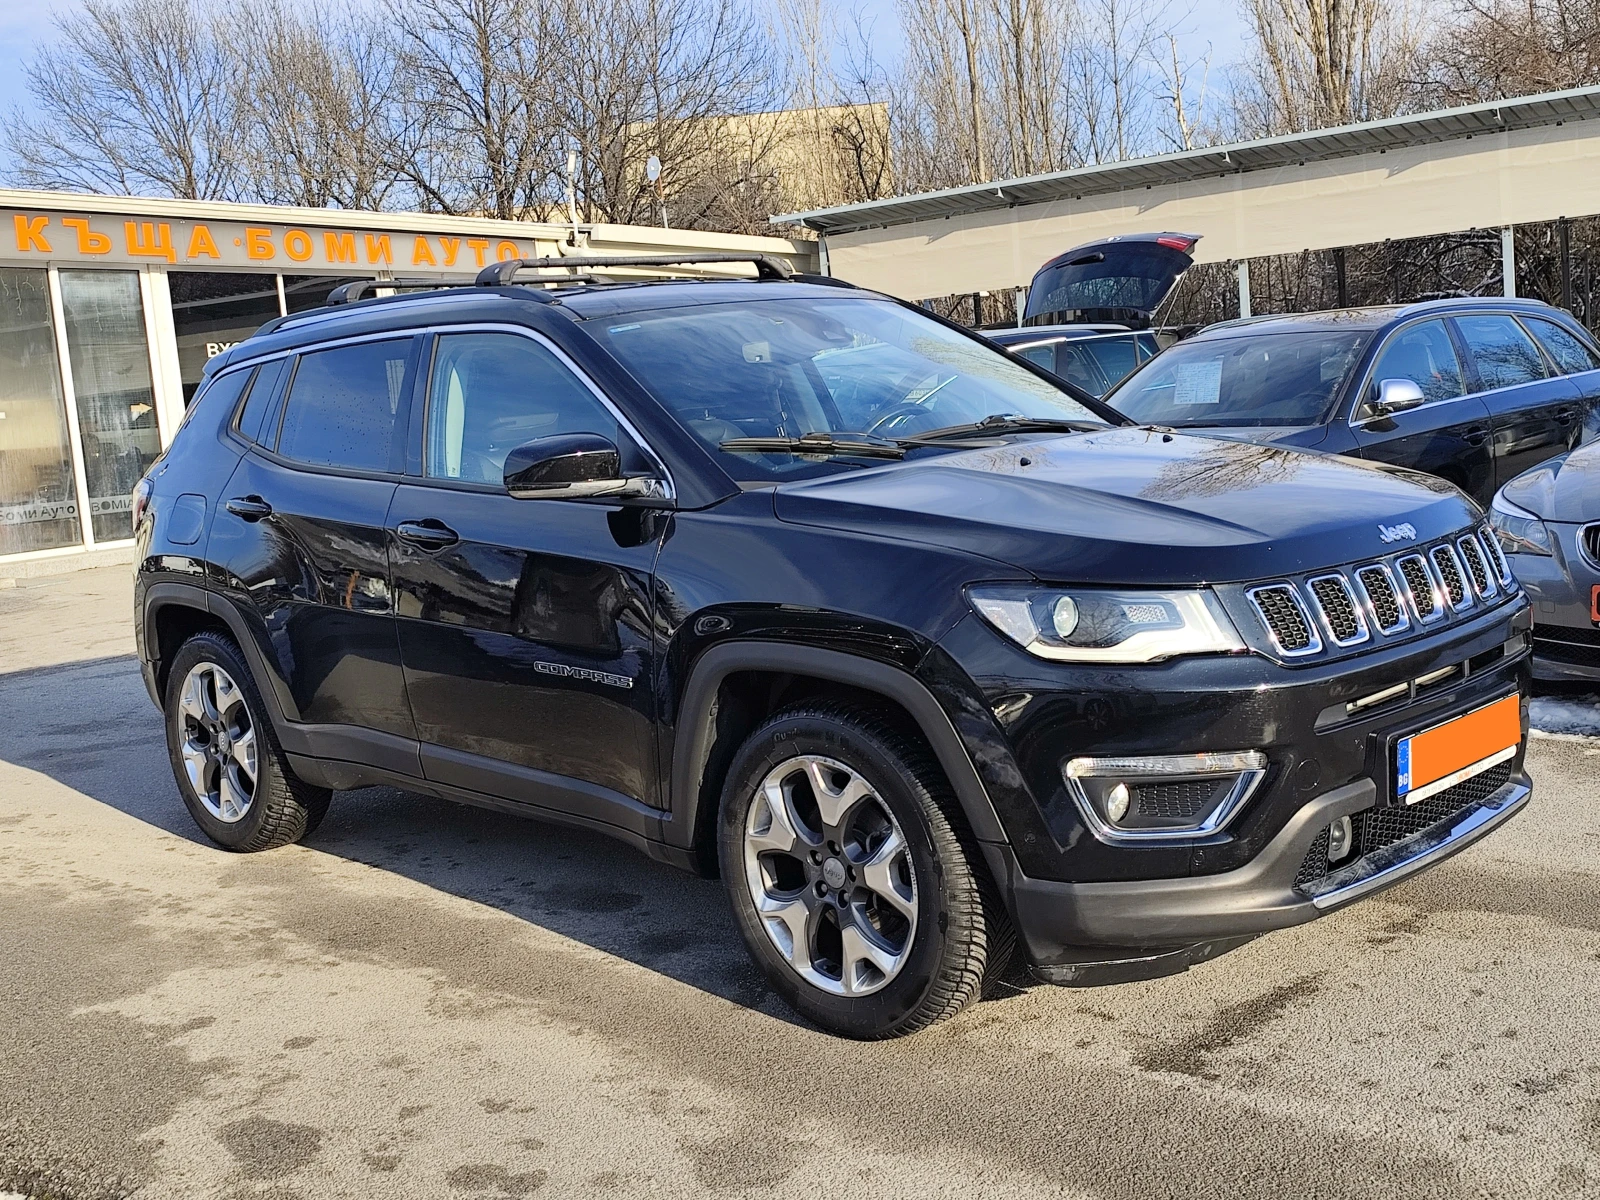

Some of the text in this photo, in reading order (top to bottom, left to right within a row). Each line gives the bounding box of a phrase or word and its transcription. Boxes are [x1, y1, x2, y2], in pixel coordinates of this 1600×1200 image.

[13, 215, 221, 264] КЪЩА
[245, 227, 393, 264] БОМИ
[1377, 522, 1417, 544] Jeep
[534, 661, 633, 689] COMPASS
[1398, 774, 1408, 787] BG
